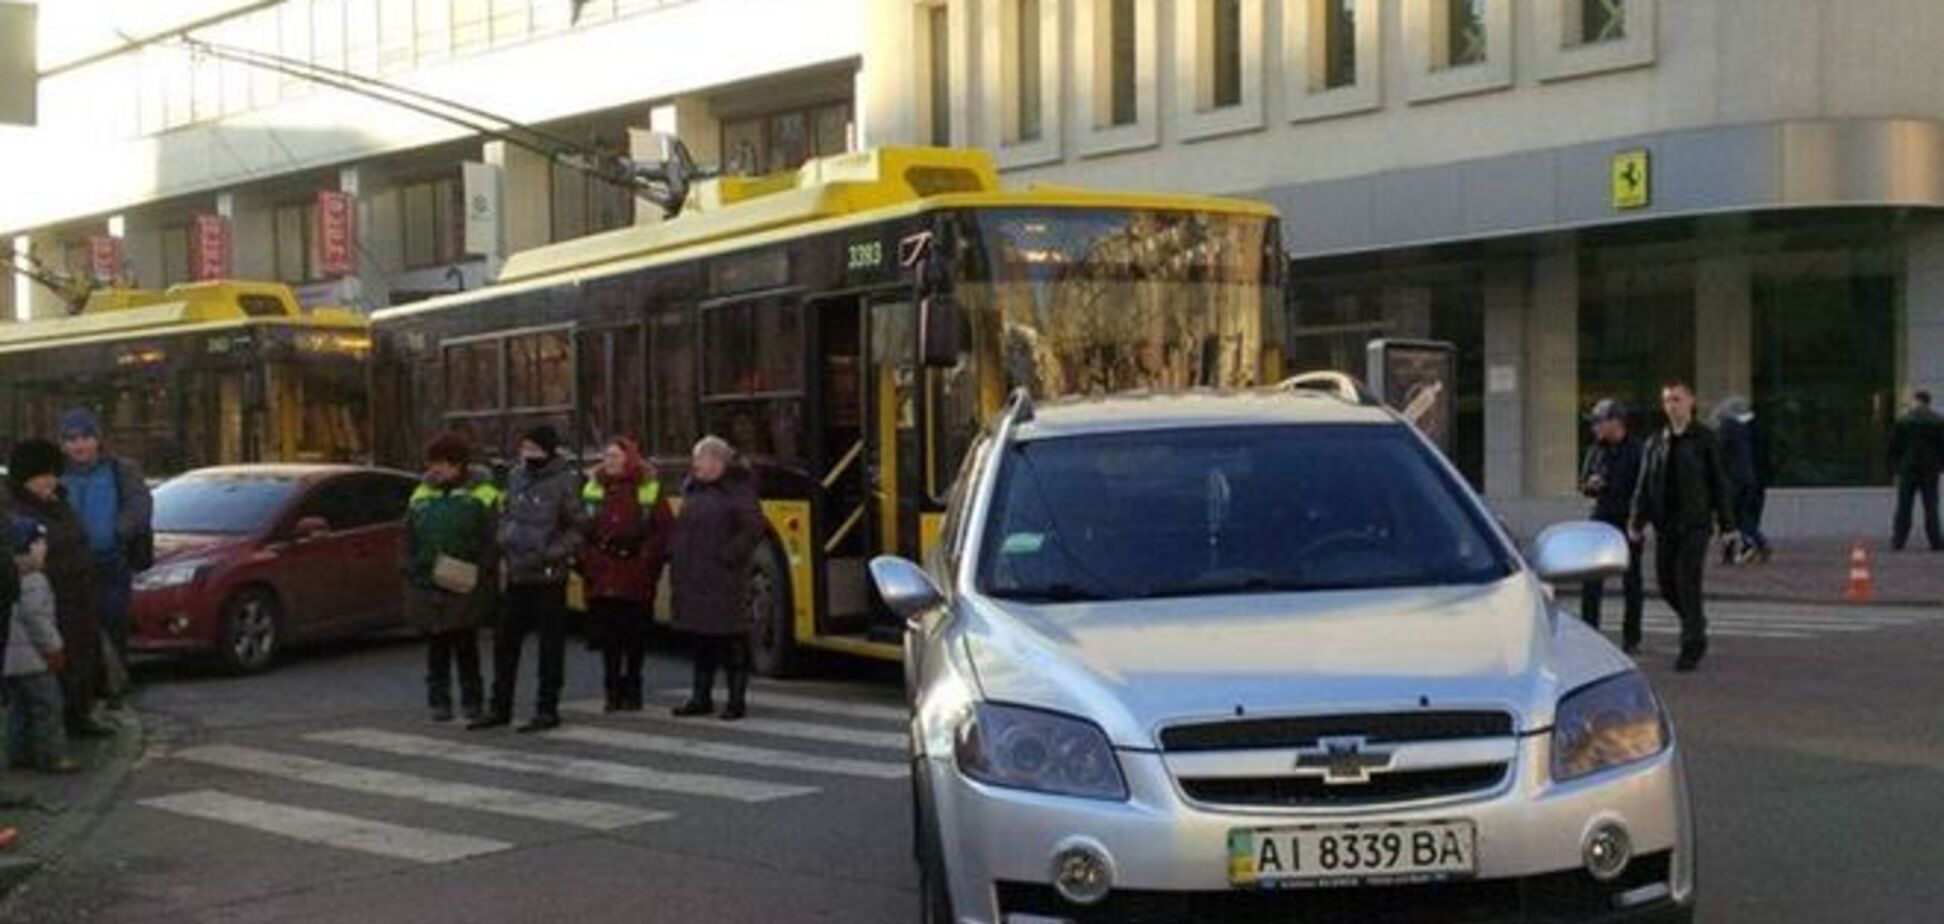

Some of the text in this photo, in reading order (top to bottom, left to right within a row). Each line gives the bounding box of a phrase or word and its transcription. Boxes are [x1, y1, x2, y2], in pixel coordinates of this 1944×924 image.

[1257, 831, 1463, 872] AI 8339 BA
